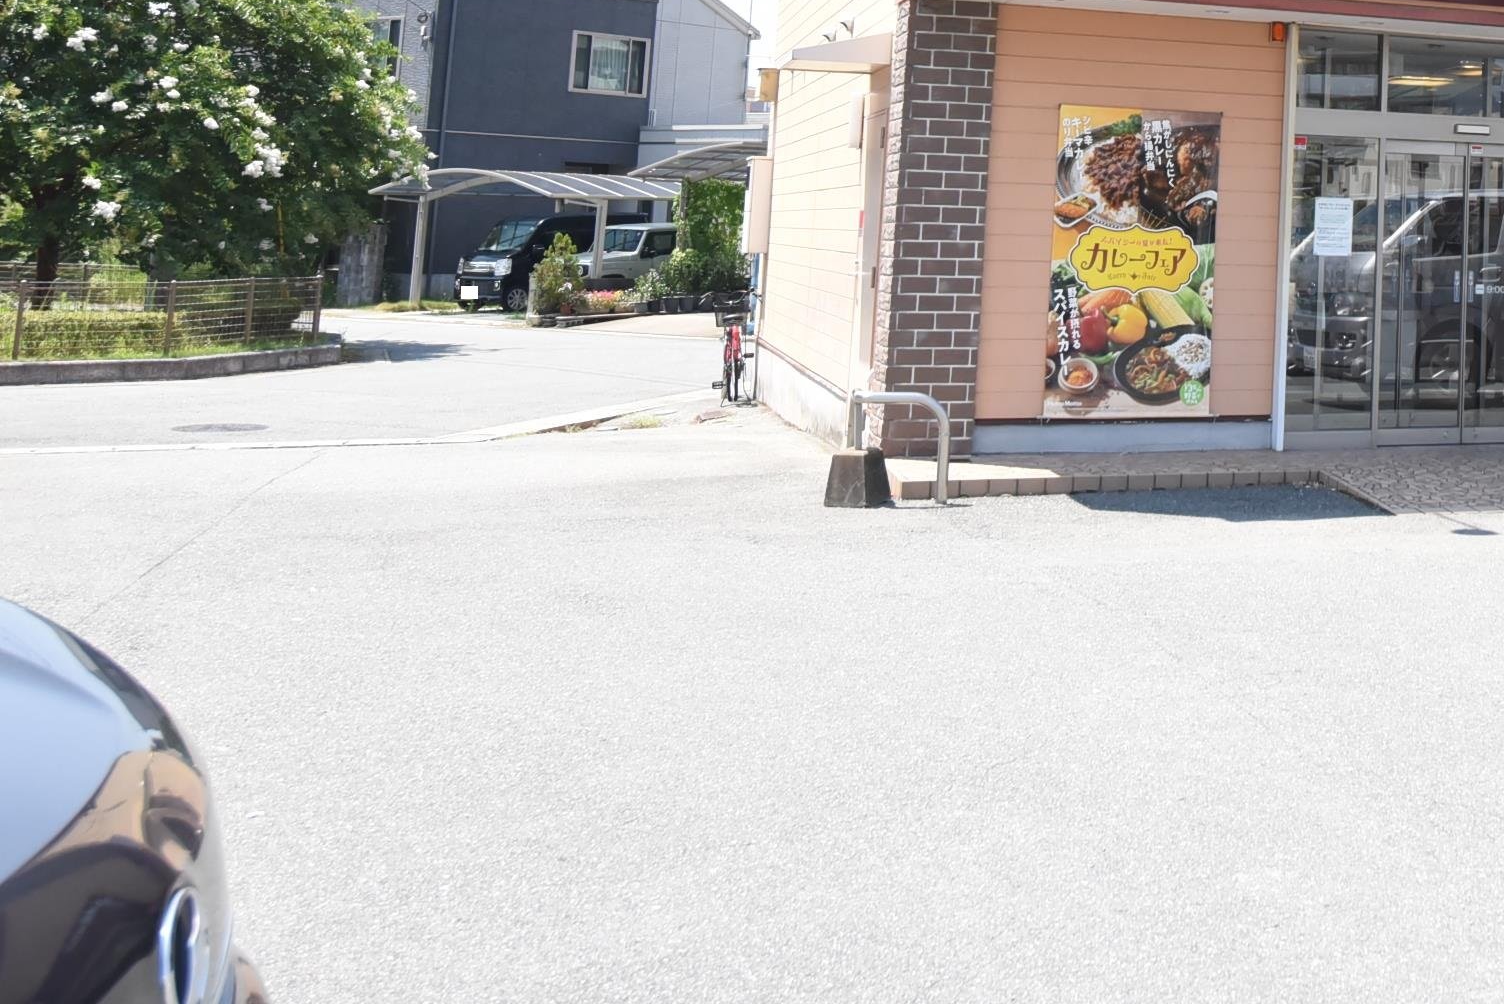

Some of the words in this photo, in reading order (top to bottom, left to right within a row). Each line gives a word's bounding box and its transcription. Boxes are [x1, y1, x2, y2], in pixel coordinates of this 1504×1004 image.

[1080, 243, 1187, 276] カレーフェア
[1053, 288, 1072, 376] スパイスカレー
